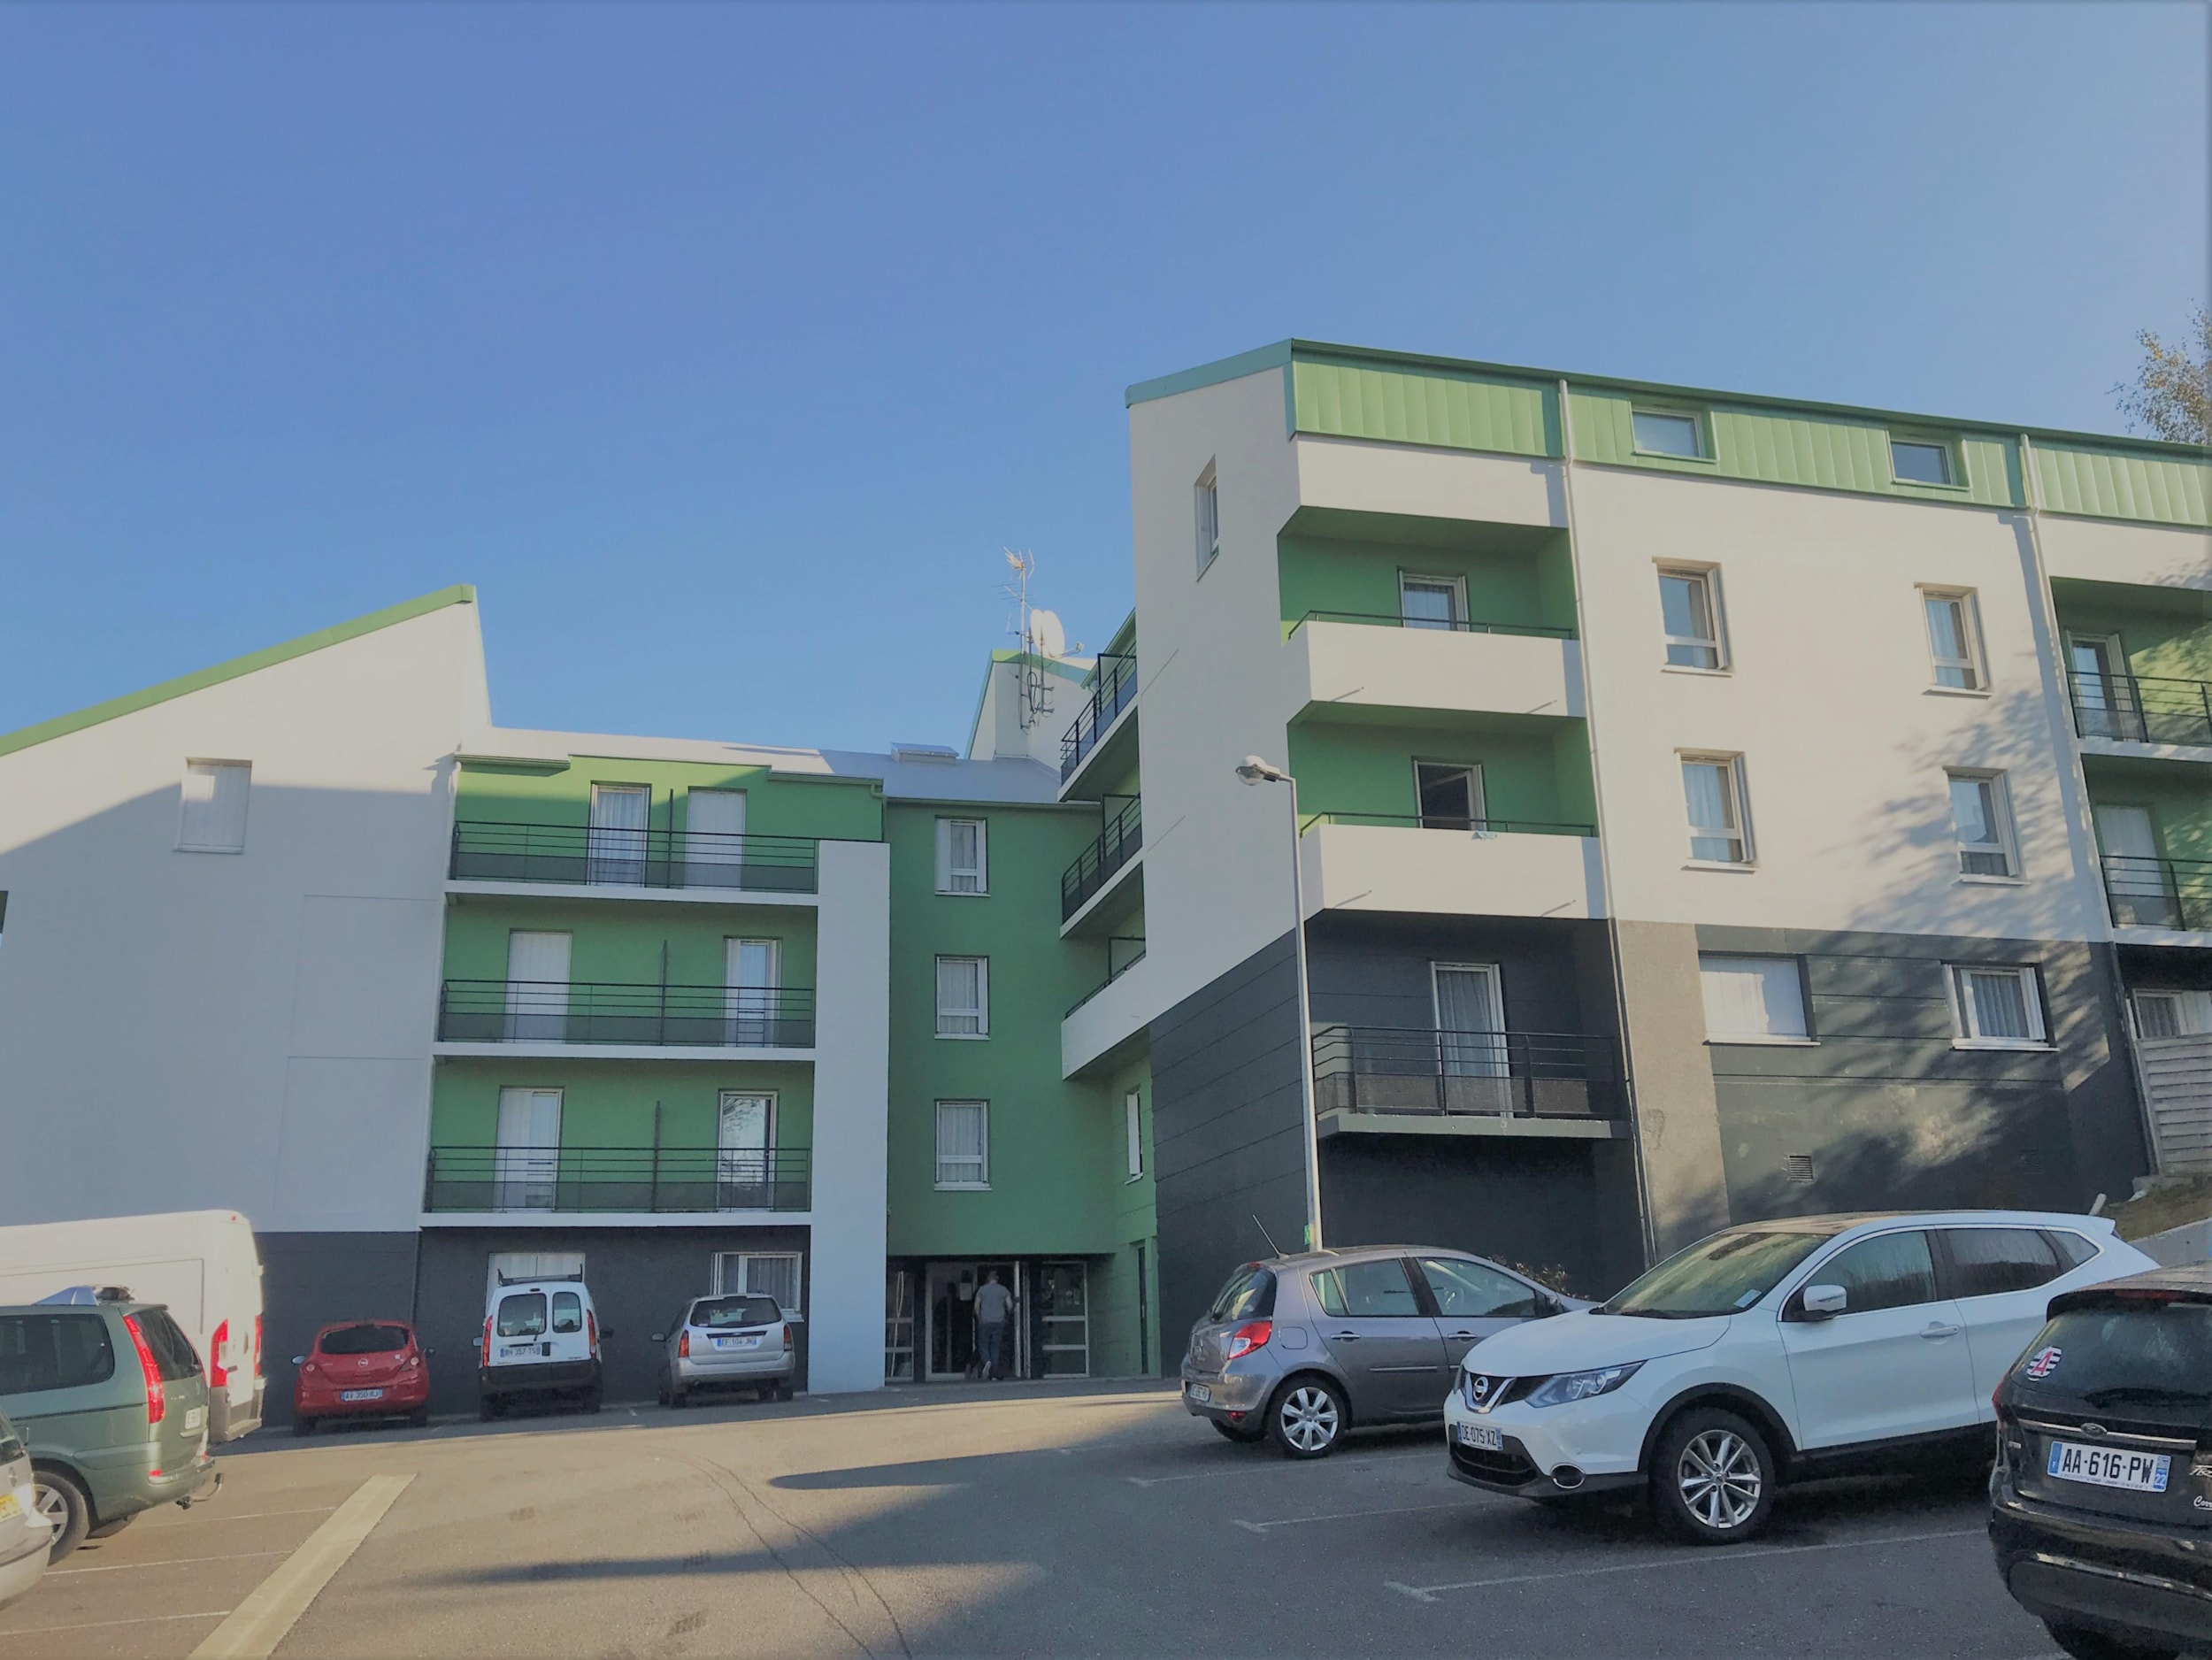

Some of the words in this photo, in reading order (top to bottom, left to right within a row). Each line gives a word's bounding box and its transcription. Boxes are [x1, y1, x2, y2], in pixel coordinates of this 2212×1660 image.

[2030, 1350, 2054, 1375] A
[2062, 1449, 2154, 1484] AA-616-PW
[2154, 1472, 2167, 1487] 22
